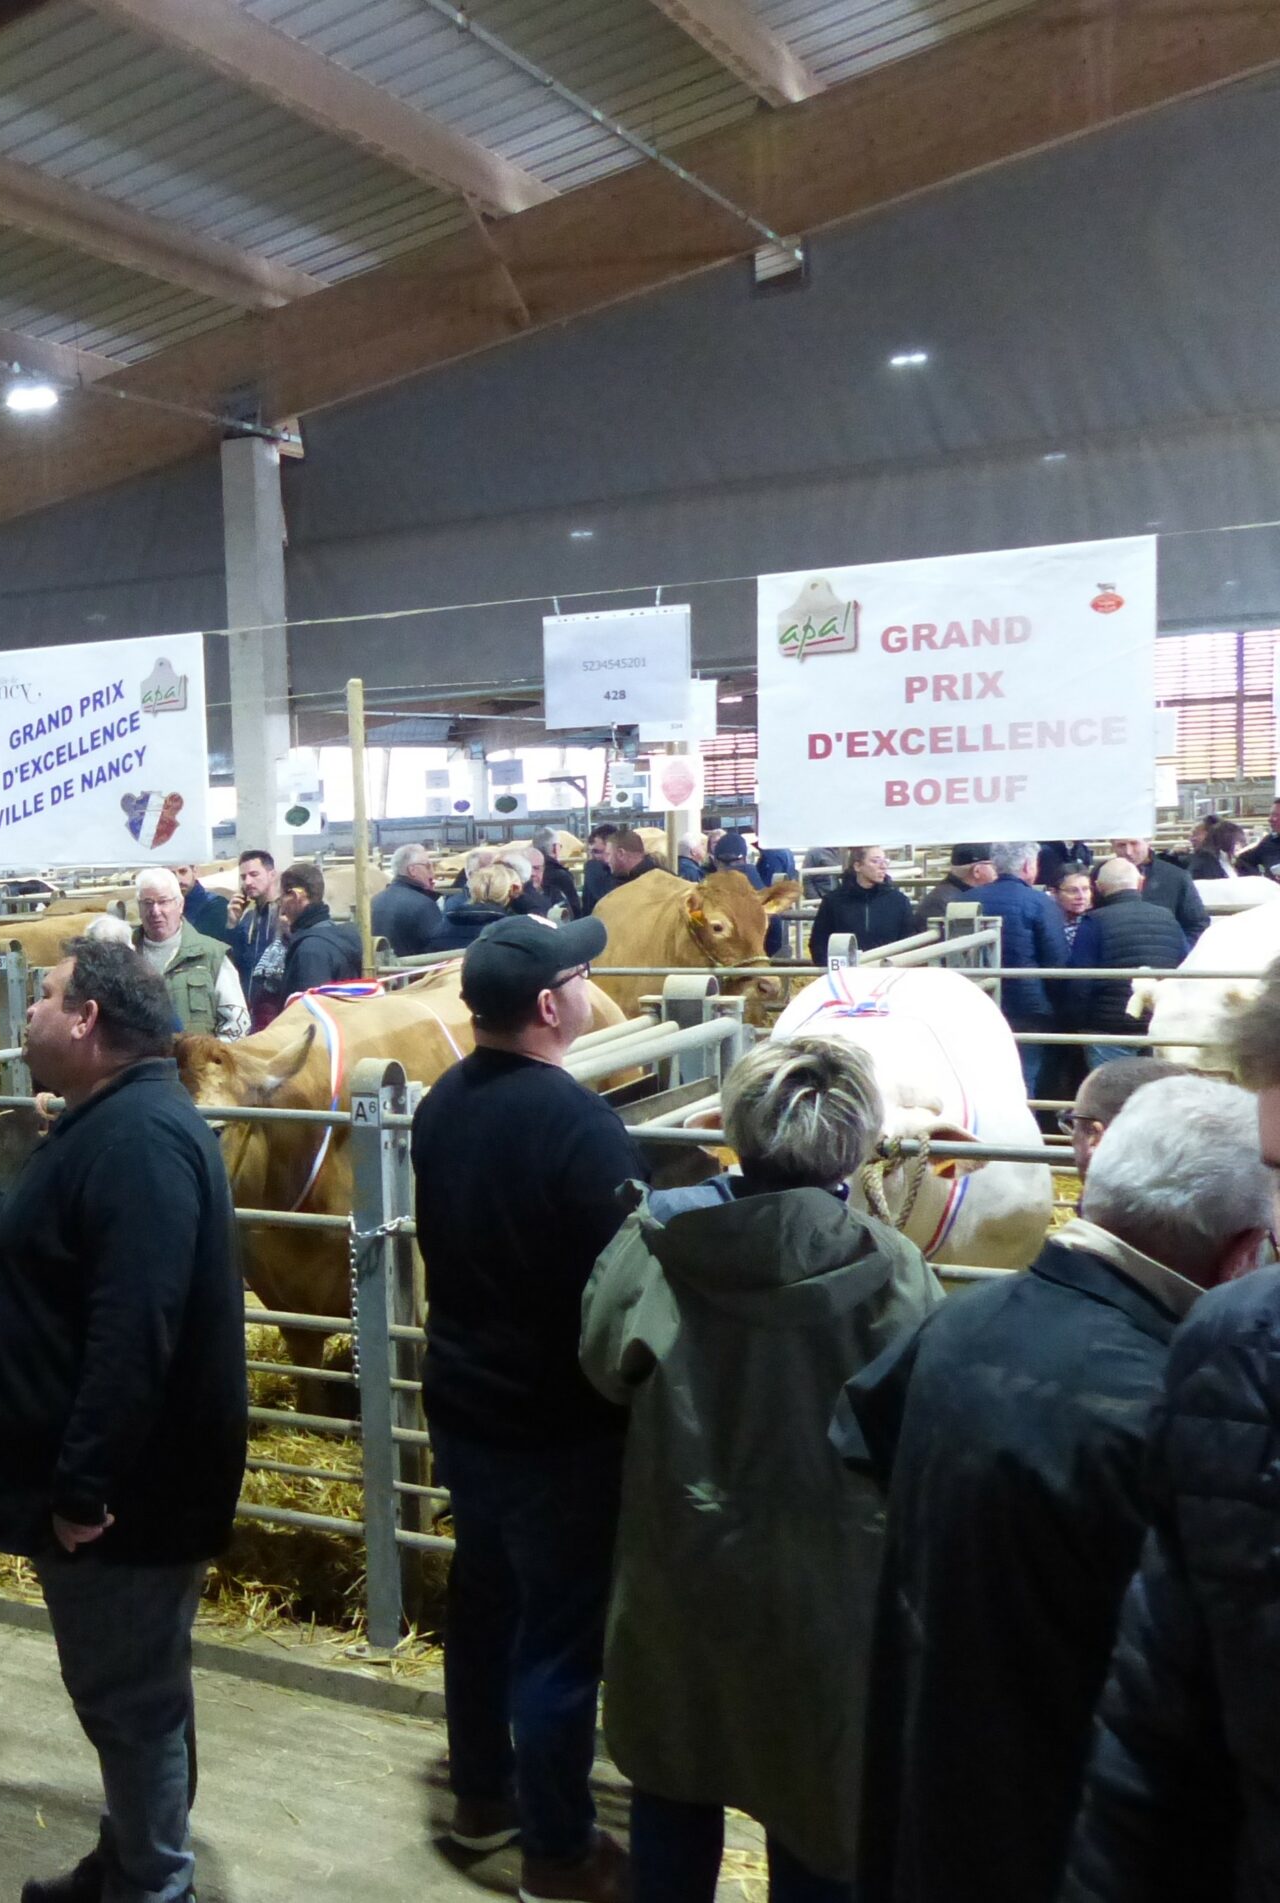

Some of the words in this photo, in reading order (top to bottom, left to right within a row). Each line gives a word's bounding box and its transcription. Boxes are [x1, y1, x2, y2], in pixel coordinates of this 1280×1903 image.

[880, 614, 1033, 654] GRAND
[904, 670, 1006, 703] PRIX
[9, 704, 74, 750] GRAND
[80, 679, 125, 718] PRIX
[3, 710, 141, 791] D'EXCELLENCE
[807, 715, 1128, 760] D'EXCELLENCE
[50, 778, 75, 806] DE
[81, 745, 147, 793] NANCY
[884, 774, 1029, 807] BOEUF
[354, 1101, 377, 1122] A6
